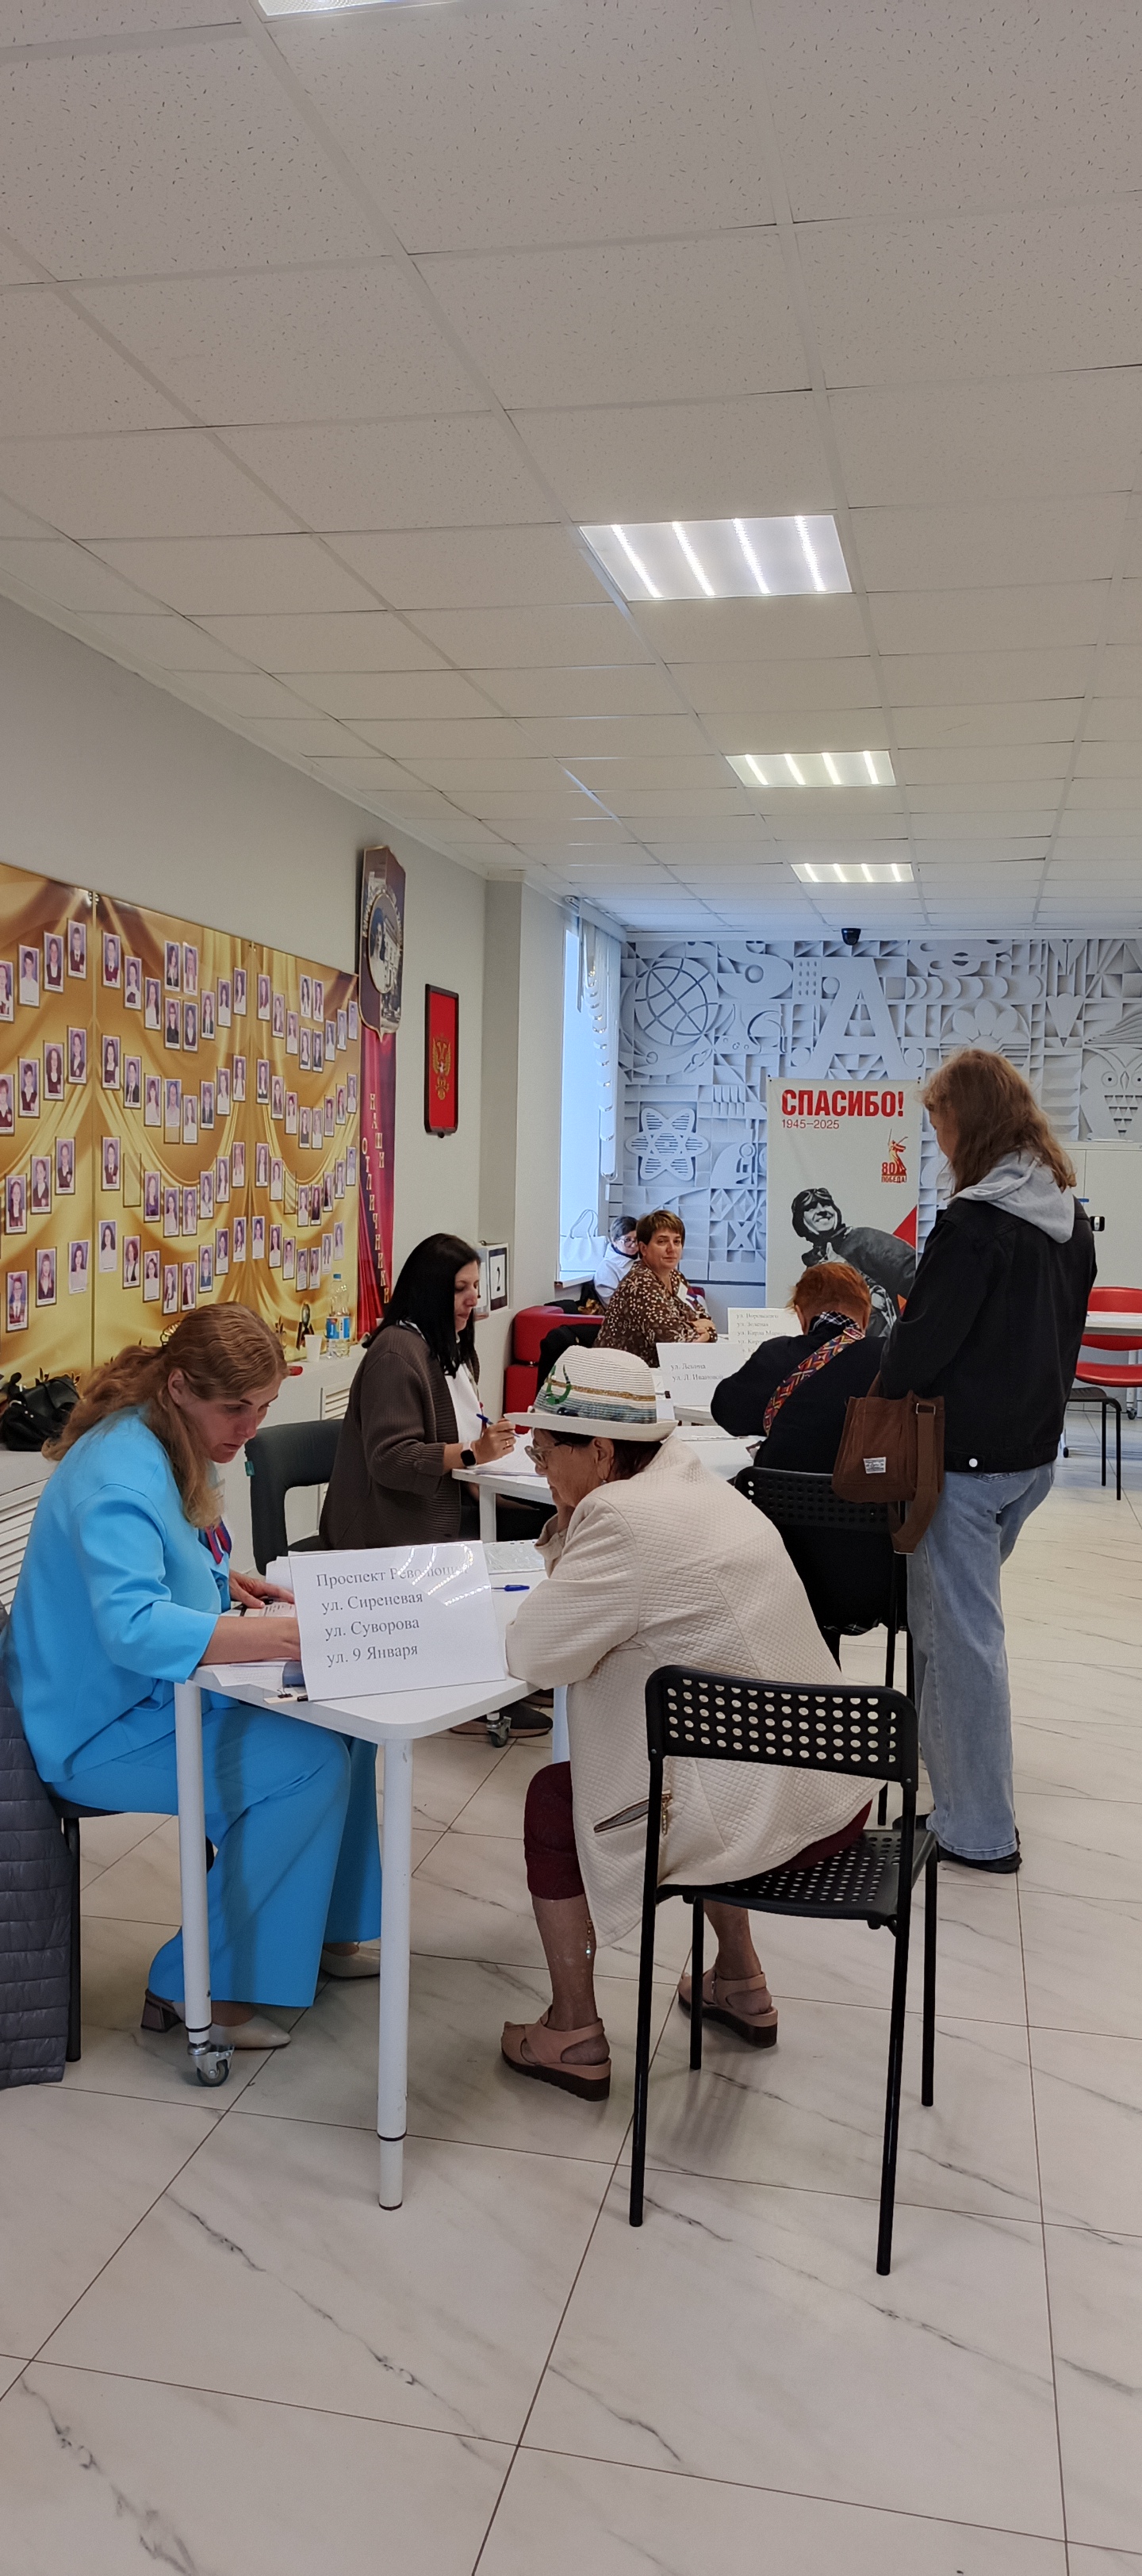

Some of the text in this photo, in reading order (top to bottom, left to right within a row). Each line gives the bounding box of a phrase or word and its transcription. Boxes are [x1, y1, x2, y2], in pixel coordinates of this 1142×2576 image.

[781, 1089, 904, 1117] СПАСИБО!
[370, 1093, 385, 1169] НАШИ
[882, 1162, 896, 1175] 80
[362, 1137, 389, 1304] ОТЛИЧНИКИ
[316, 1566, 468, 1589] Проспект Ревоюц
[321, 1592, 423, 1615] ул. Сиреневая
[325, 1619, 420, 1641] ул. Суворова
[327, 1644, 419, 1667] ул. 9 Января
